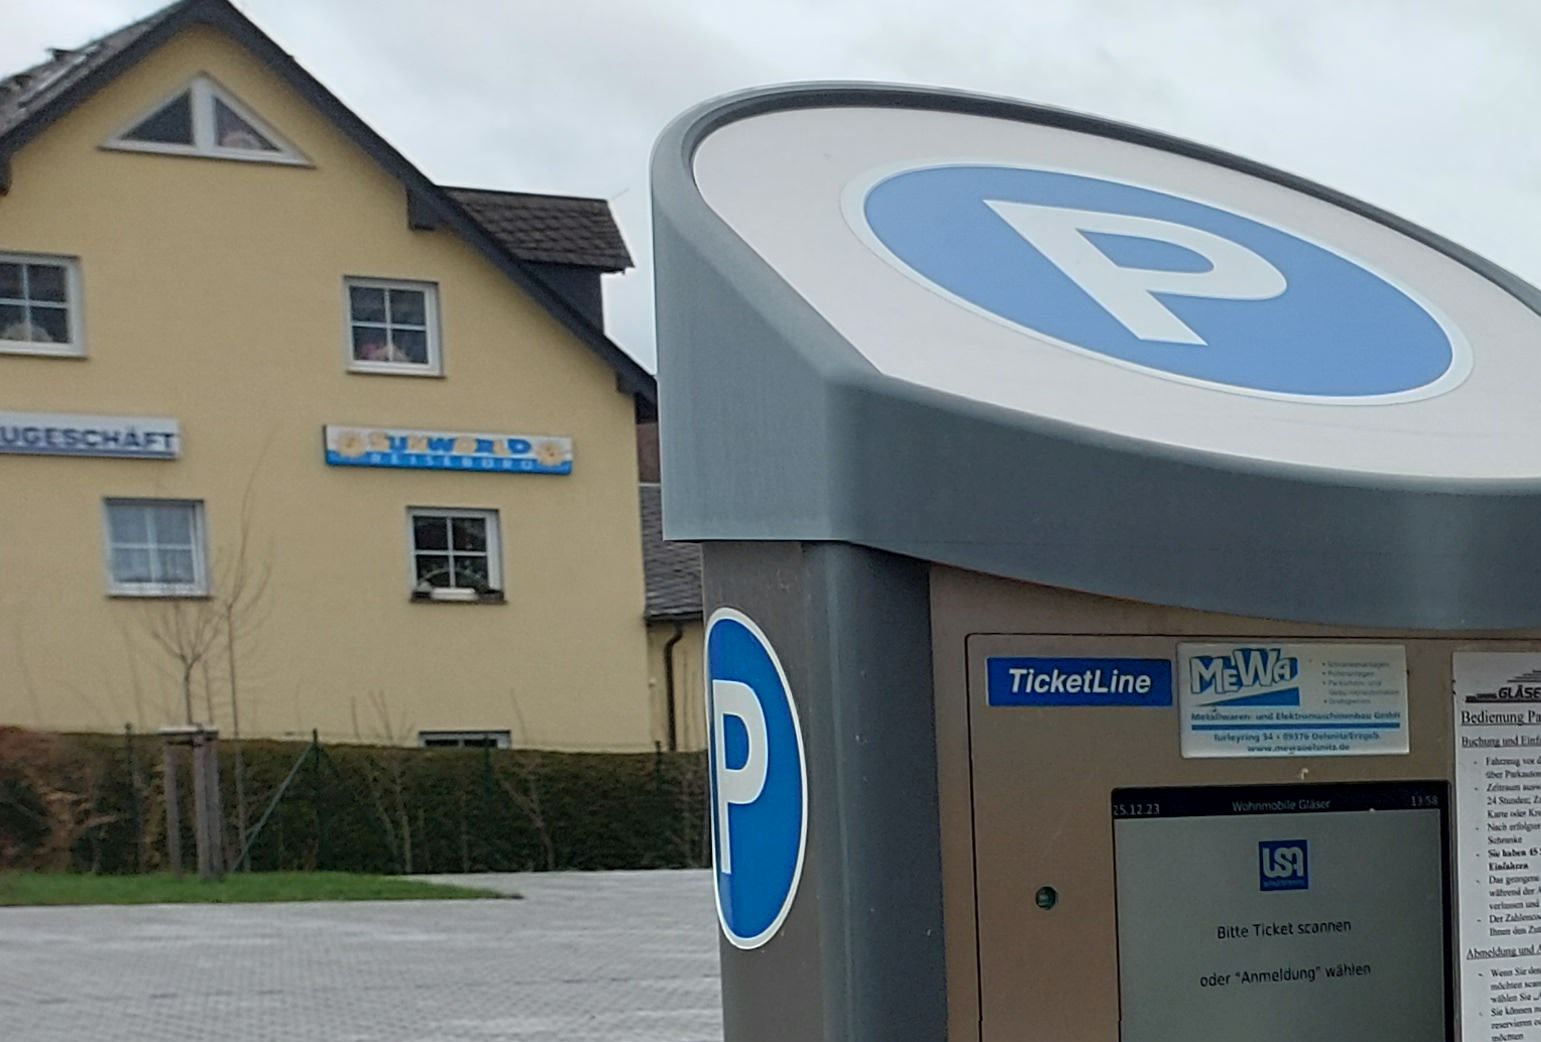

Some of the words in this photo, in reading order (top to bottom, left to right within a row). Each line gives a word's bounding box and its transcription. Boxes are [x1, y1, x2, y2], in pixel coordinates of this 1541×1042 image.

[982, 198, 1289, 346] P
[1008, 668, 1151, 694] TicketLine
[1462, 710, 1524, 726] Bedienung
[1462, 736, 1500, 747] Buchung
[1502, 736, 1518, 747] und
[712, 680, 768, 875] P
[1232, 800, 1295, 812] Wohnmobile
[1217, 926, 1248, 939] Bitte
[1252, 923, 1294, 937] Ticket
[1298, 919, 1352, 934] scannen
[1519, 944, 1535, 956] und
[1200, 973, 1231, 987] oder
[1326, 963, 1371, 978] wählen
